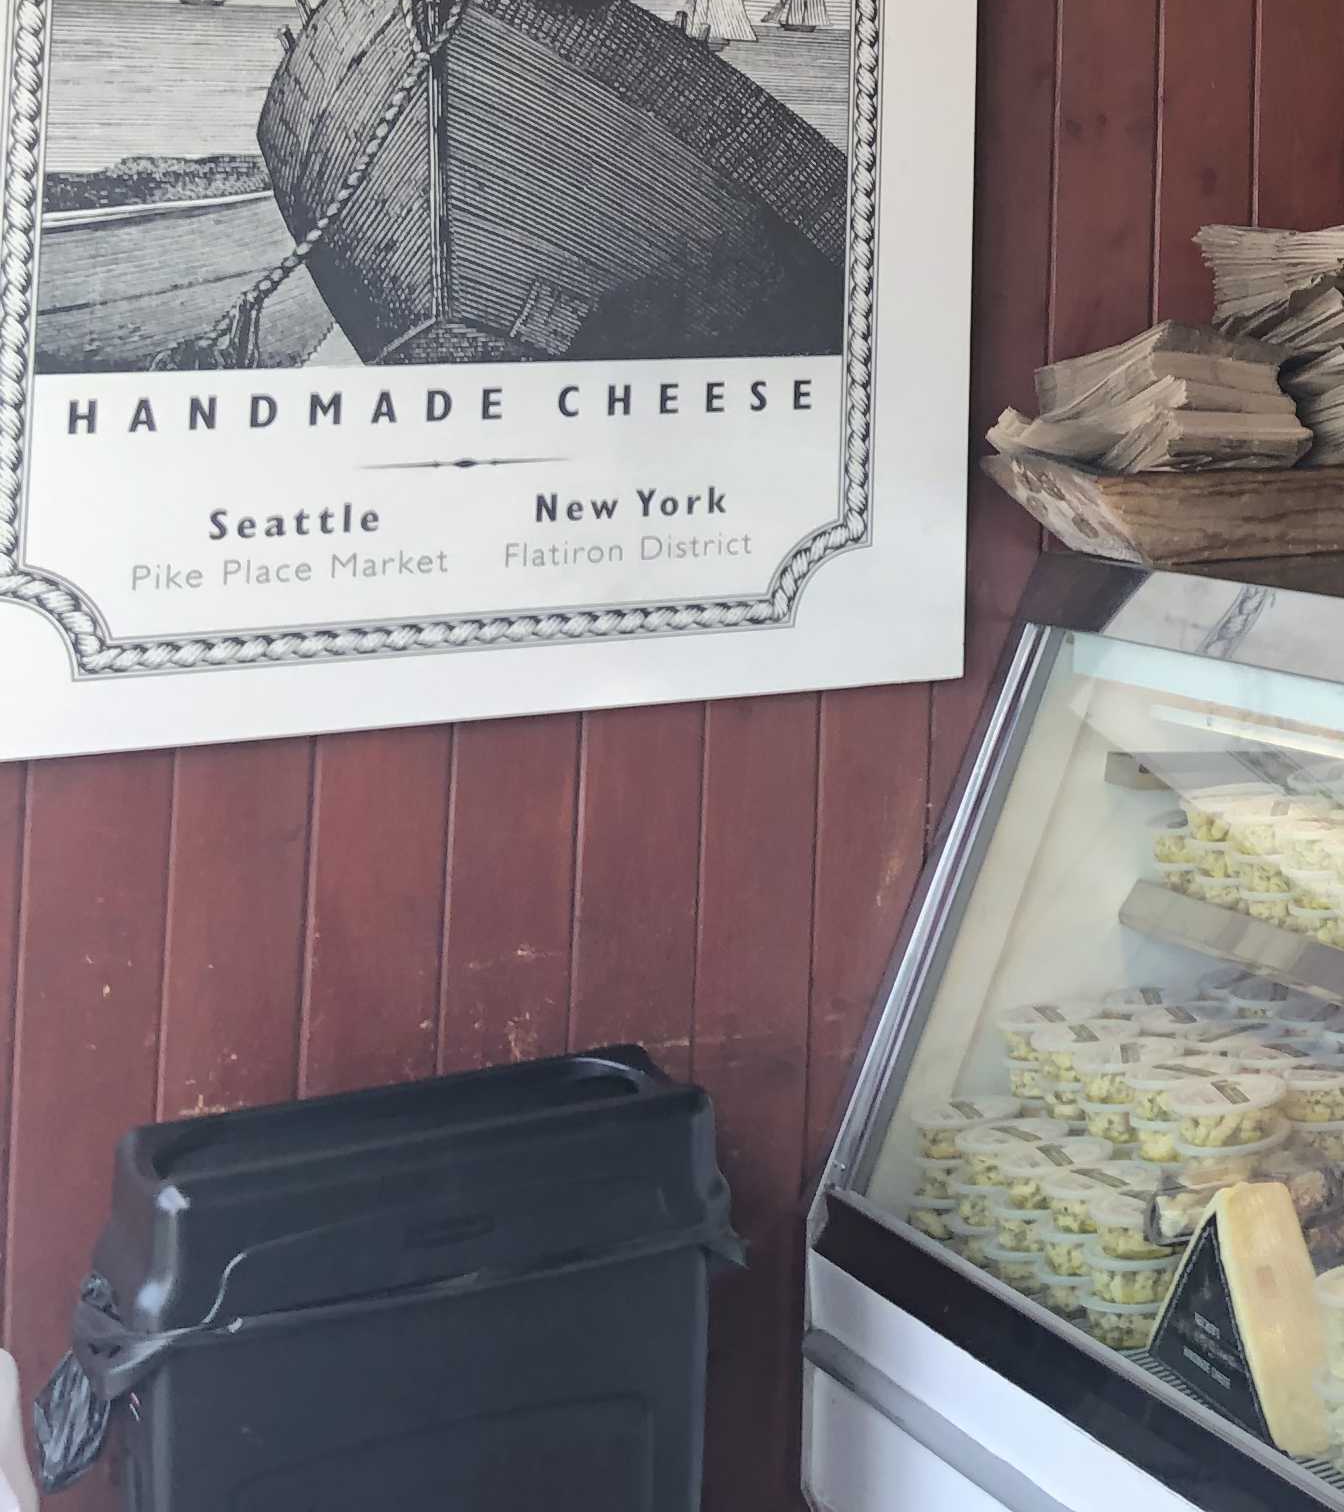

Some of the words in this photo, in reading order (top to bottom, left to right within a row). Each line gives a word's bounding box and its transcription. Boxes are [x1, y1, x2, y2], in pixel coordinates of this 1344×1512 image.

[67, 387, 503, 434] HANDMADE
[557, 379, 812, 417] CHEESE
[208, 502, 380, 541] Seattle
[535, 493, 618, 523] New
[636, 486, 727, 517] York
[131, 563, 204, 592] Pike
[222, 558, 312, 586] Place
[331, 548, 449, 579] Market
[505, 541, 624, 569] Flatiron
[641, 532, 752, 561] District
